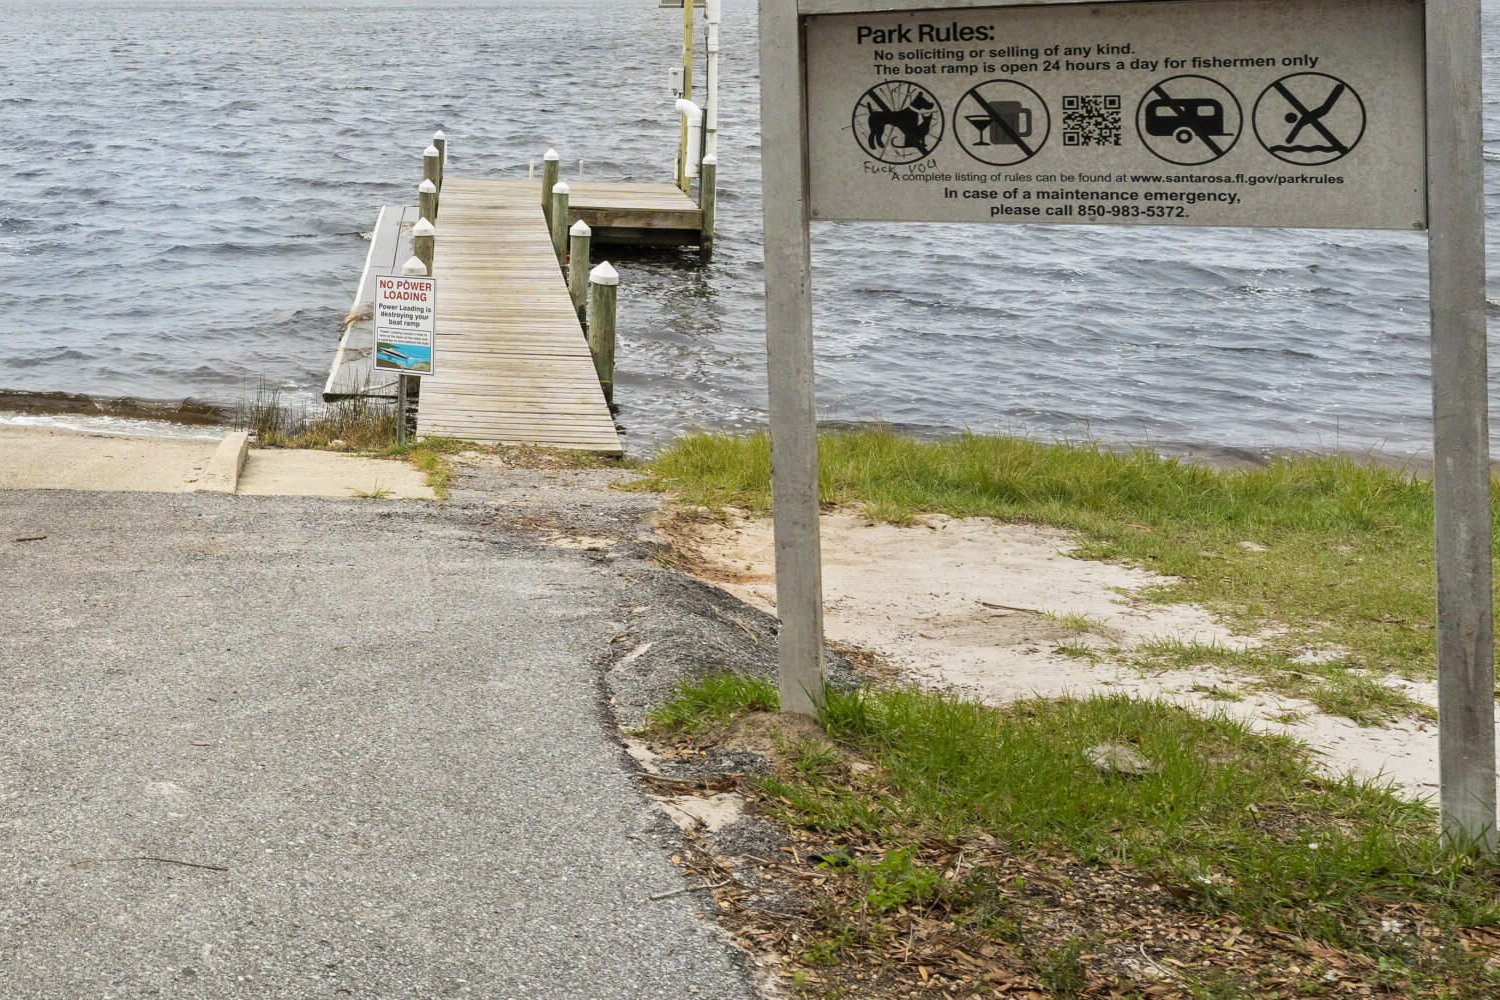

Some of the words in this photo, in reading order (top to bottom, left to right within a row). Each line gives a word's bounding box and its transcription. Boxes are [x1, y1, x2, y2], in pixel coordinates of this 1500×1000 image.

[856, 24, 912, 44] Park
[918, 22, 995, 43] Rules:
[874, 50, 893, 60] No
[898, 48, 964, 61] soliciting
[969, 48, 985, 58] or
[989, 46, 1039, 59] selling
[1044, 45, 1060, 56] of
[1064, 46, 1092, 58] any
[1097, 43, 1135, 55] kind.
[874, 64, 900, 75] The
[905, 63, 937, 74] boat
[941, 64, 978, 76] ramp
[983, 62, 996, 73] is
[1000, 62, 1038, 74] open
[1043, 60, 1061, 72] 24
[1066, 60, 1111, 71] hours
[1115, 61, 1125, 70] a
[1130, 58, 1158, 72] day
[1164, 57, 1188, 69] for
[1191, 56, 1276, 68] fishermen
[1282, 54, 1319, 69] only
[891, 172, 900, 181] A
[902, 172, 952, 183] complete
[955, 172, 988, 184] listing
[990, 172, 1003, 182] of
[1004, 172, 1033, 183] rules
[1036, 174, 1056, 183] can
[1061, 173, 1075, 183] be
[1078, 173, 1112, 183] found
[1116, 174, 1128, 183] at
[1130, 173, 1345, 185] www.santarosa.fl.gov/parkrules
[944, 187, 958, 199] In
[963, 190, 998, 199] case
[1002, 188, 1019, 199] of
[1022, 190, 1032, 200] a
[1036, 188, 1139, 200] maintenance
[1144, 190, 1241, 204] emergency,
[990, 204, 1041, 217] please
[1045, 204, 1073, 216] call
[1078, 204, 1190, 218] 850-983-5372.
[379, 280, 394, 289] NO
[396, 281, 432, 292] POWER
[383, 291, 427, 302] LOADING
[380, 311, 413, 320] destroying
[399, 305, 424, 313] Loading
